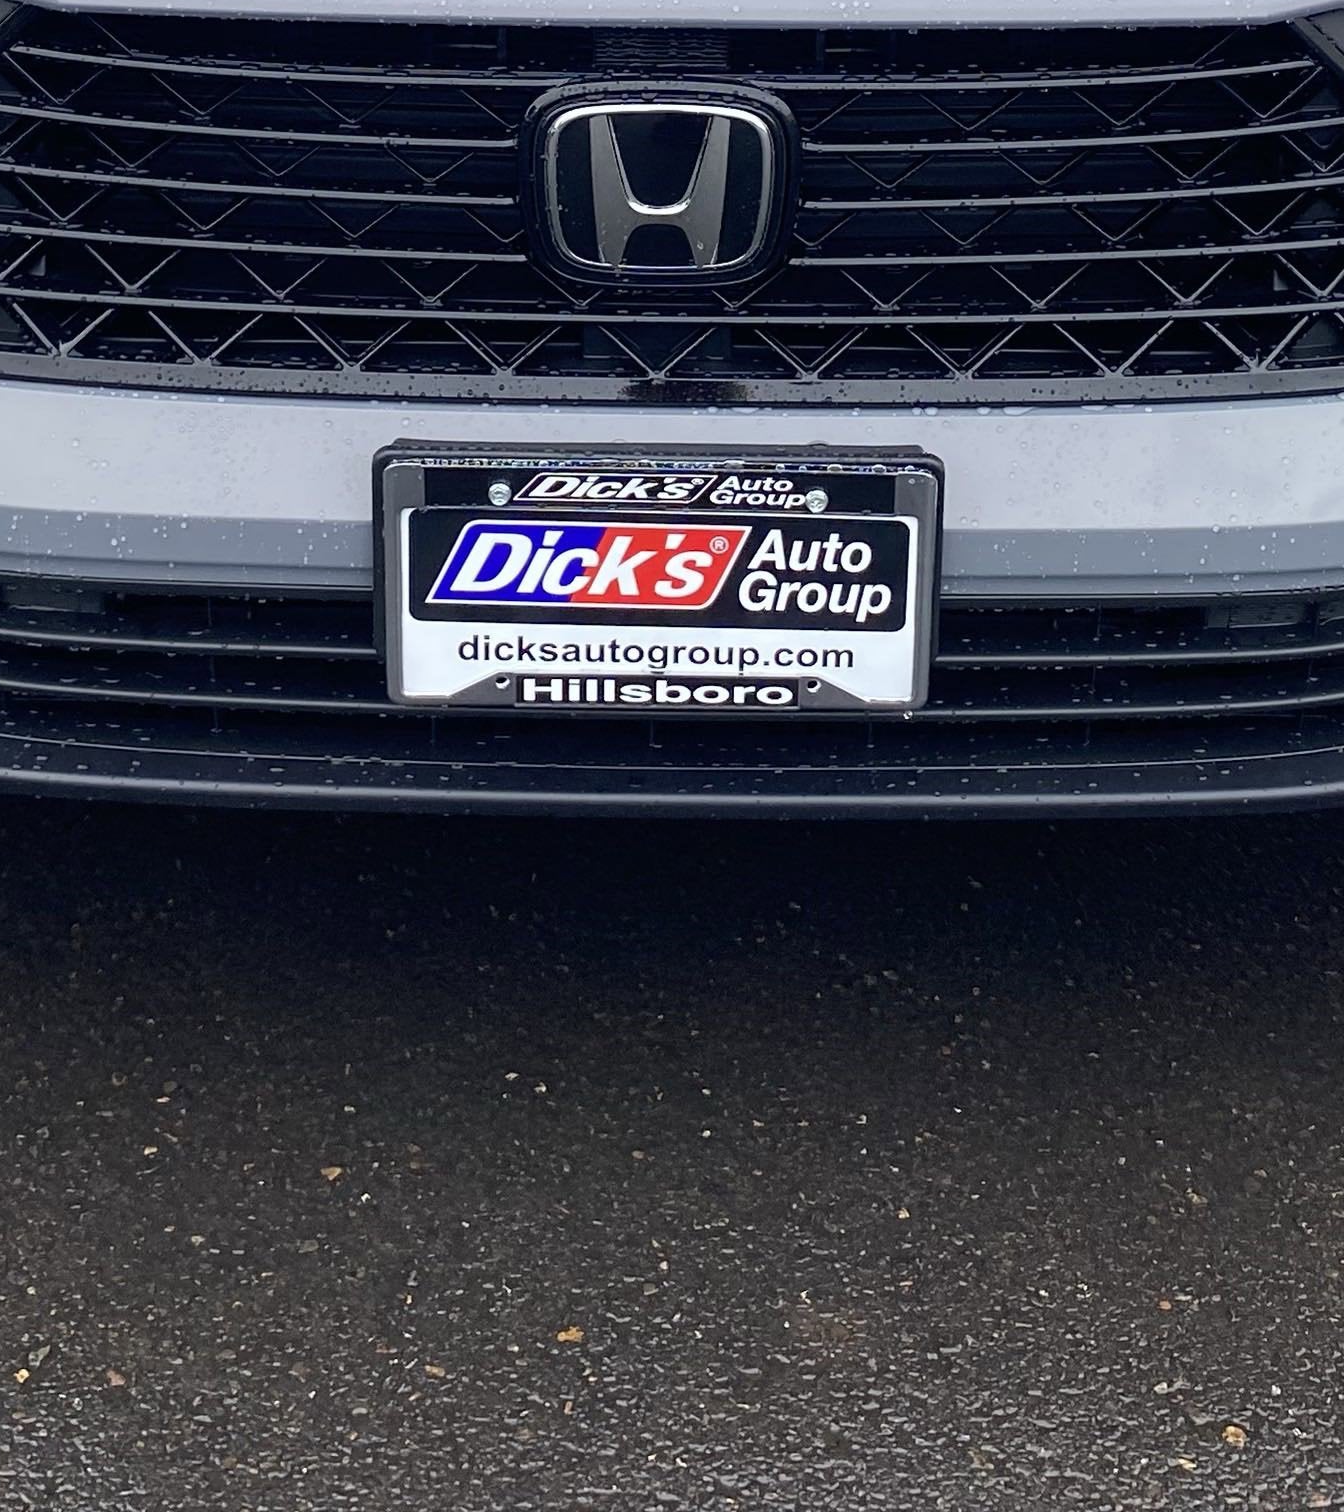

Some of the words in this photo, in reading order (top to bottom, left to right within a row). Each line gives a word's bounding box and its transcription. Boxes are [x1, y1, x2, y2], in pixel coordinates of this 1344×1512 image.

[716, 476, 793, 491] Auto
[710, 490, 806, 509] Group
[747, 529, 871, 574] Auto
[738, 574, 892, 622] Group
[458, 635, 855, 669] dicksautogroup.com
[521, 678, 794, 705] Hillsboro
